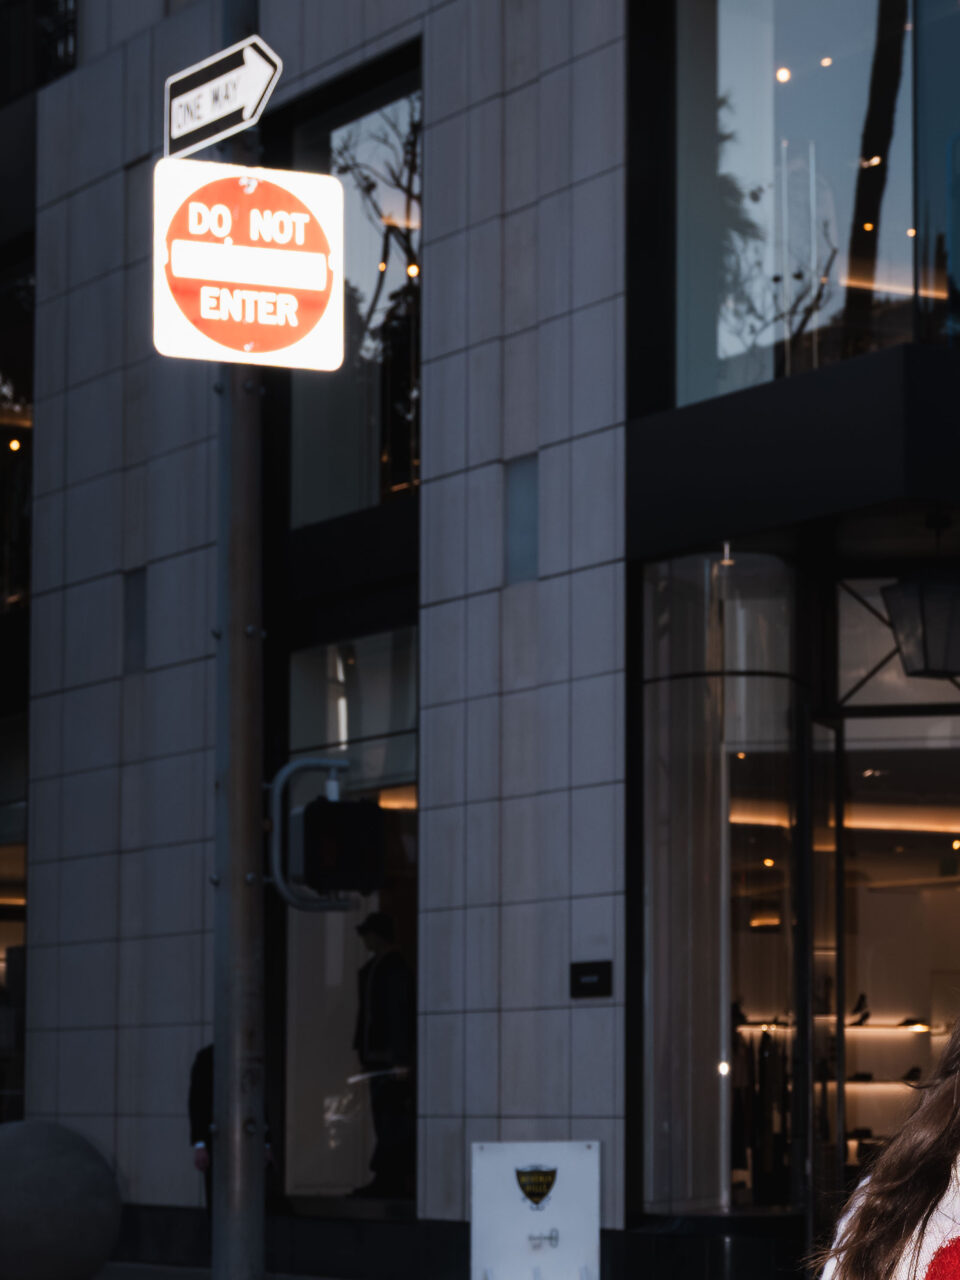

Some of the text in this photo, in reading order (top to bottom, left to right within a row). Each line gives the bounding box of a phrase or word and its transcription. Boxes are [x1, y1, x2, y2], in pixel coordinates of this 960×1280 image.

[175, 77, 240, 130] ONE WAY
[188, 201, 310, 246] DO NOT
[200, 286, 299, 327] ENTER
